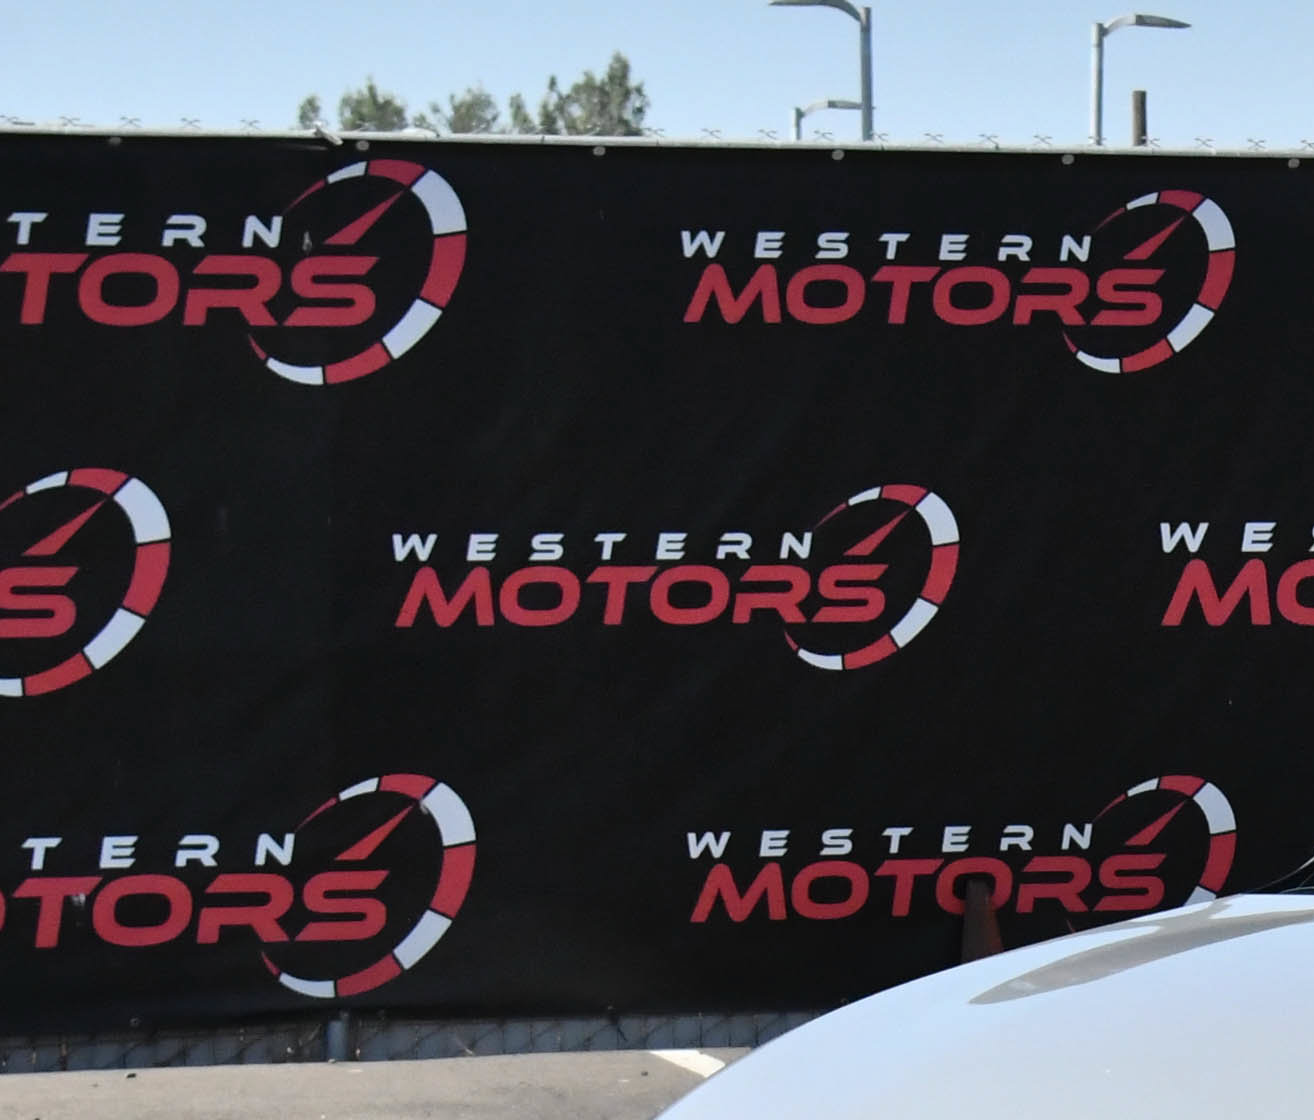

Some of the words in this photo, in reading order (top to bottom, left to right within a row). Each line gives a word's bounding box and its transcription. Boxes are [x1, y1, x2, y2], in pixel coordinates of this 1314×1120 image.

[8, 213, 282, 247] TERN
[682, 230, 1090, 261] WESTERN
[685, 264, 1164, 325] MOTORS
[393, 532, 812, 561] WESTERN
[396, 564, 888, 627] MOTORS
[23, 833, 294, 869] TERN
[688, 823, 1092, 858] WESTERN
[691, 854, 1166, 922] MOTORS
[0, 870, 388, 948] TORS
